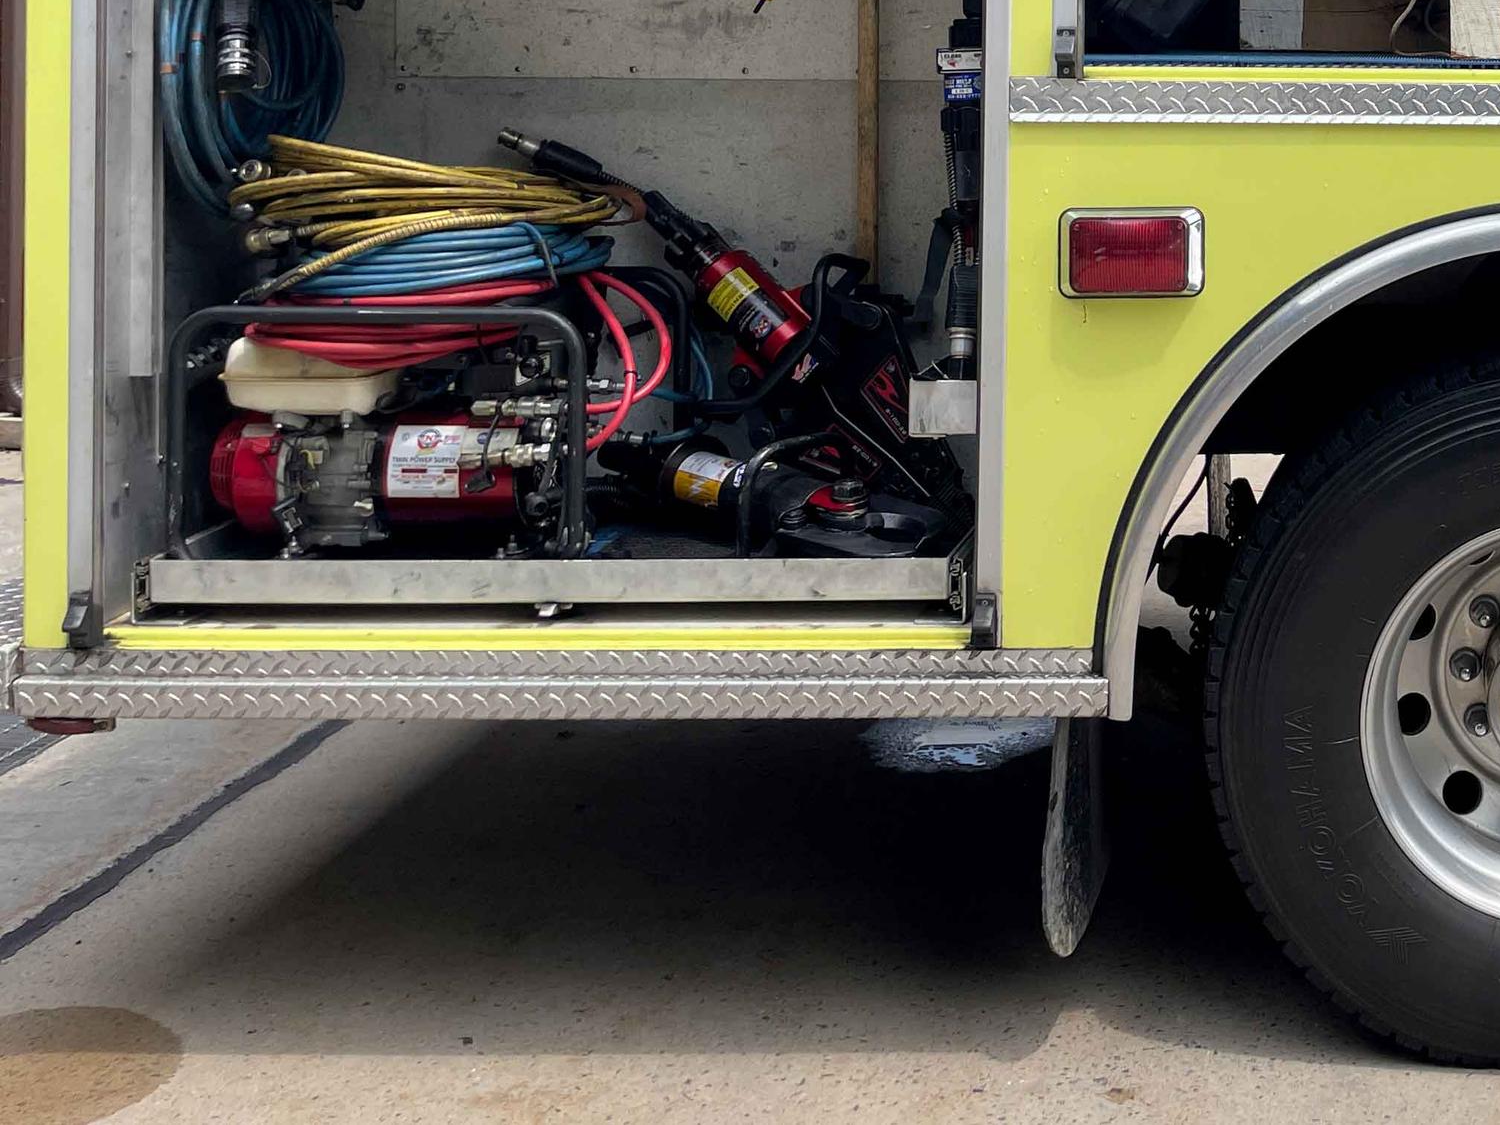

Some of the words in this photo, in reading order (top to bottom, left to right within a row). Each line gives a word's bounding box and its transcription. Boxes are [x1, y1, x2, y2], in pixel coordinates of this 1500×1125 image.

[409, 456, 432, 464] POWER
[433, 456, 456, 465] SUPPLY
[1283, 704, 1376, 927] YOKOHAMA
